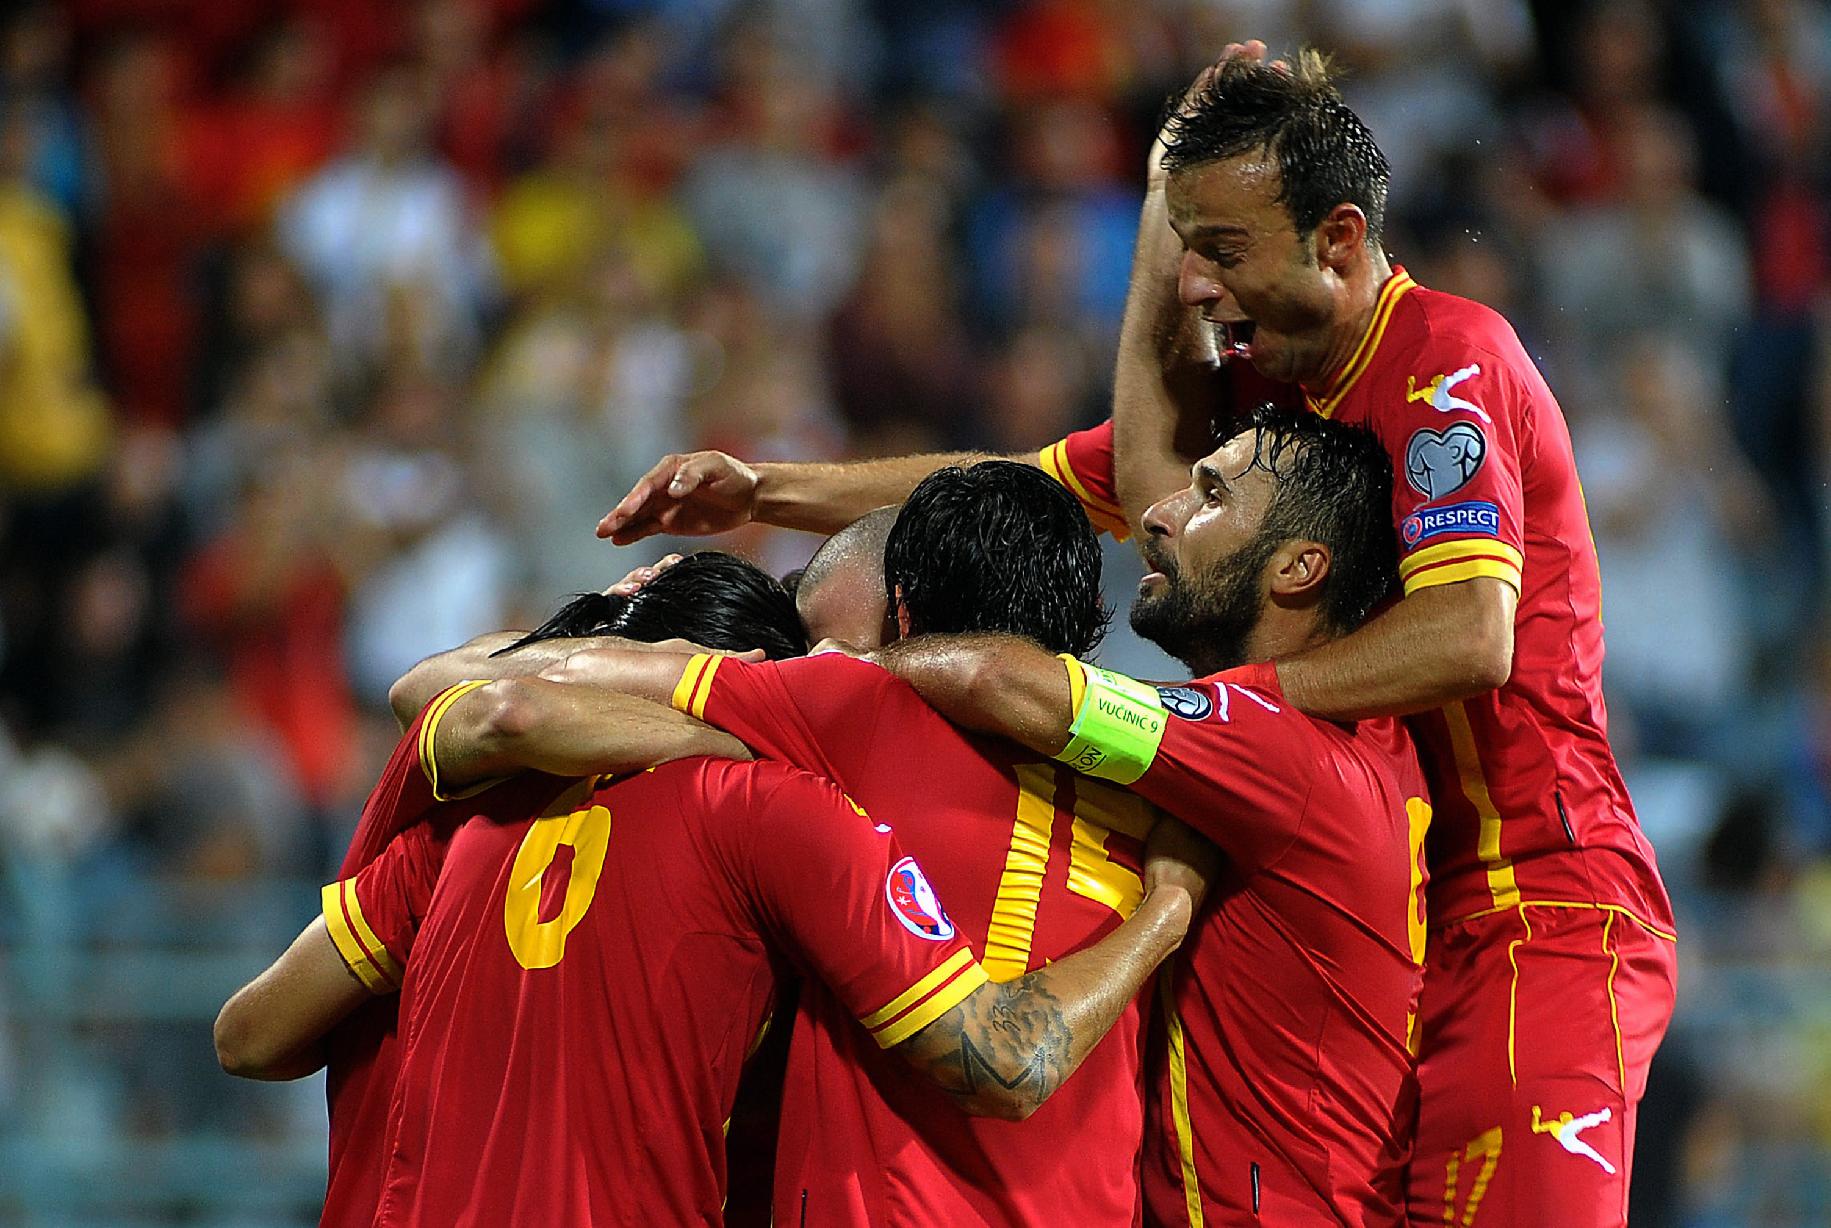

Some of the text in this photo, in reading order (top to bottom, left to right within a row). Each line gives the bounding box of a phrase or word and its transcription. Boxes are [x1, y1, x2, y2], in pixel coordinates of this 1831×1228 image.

[1424, 509, 1500, 529] RESPECT
[1150, 720, 1159, 733] 9
[1443, 1125, 1503, 1228] 17
